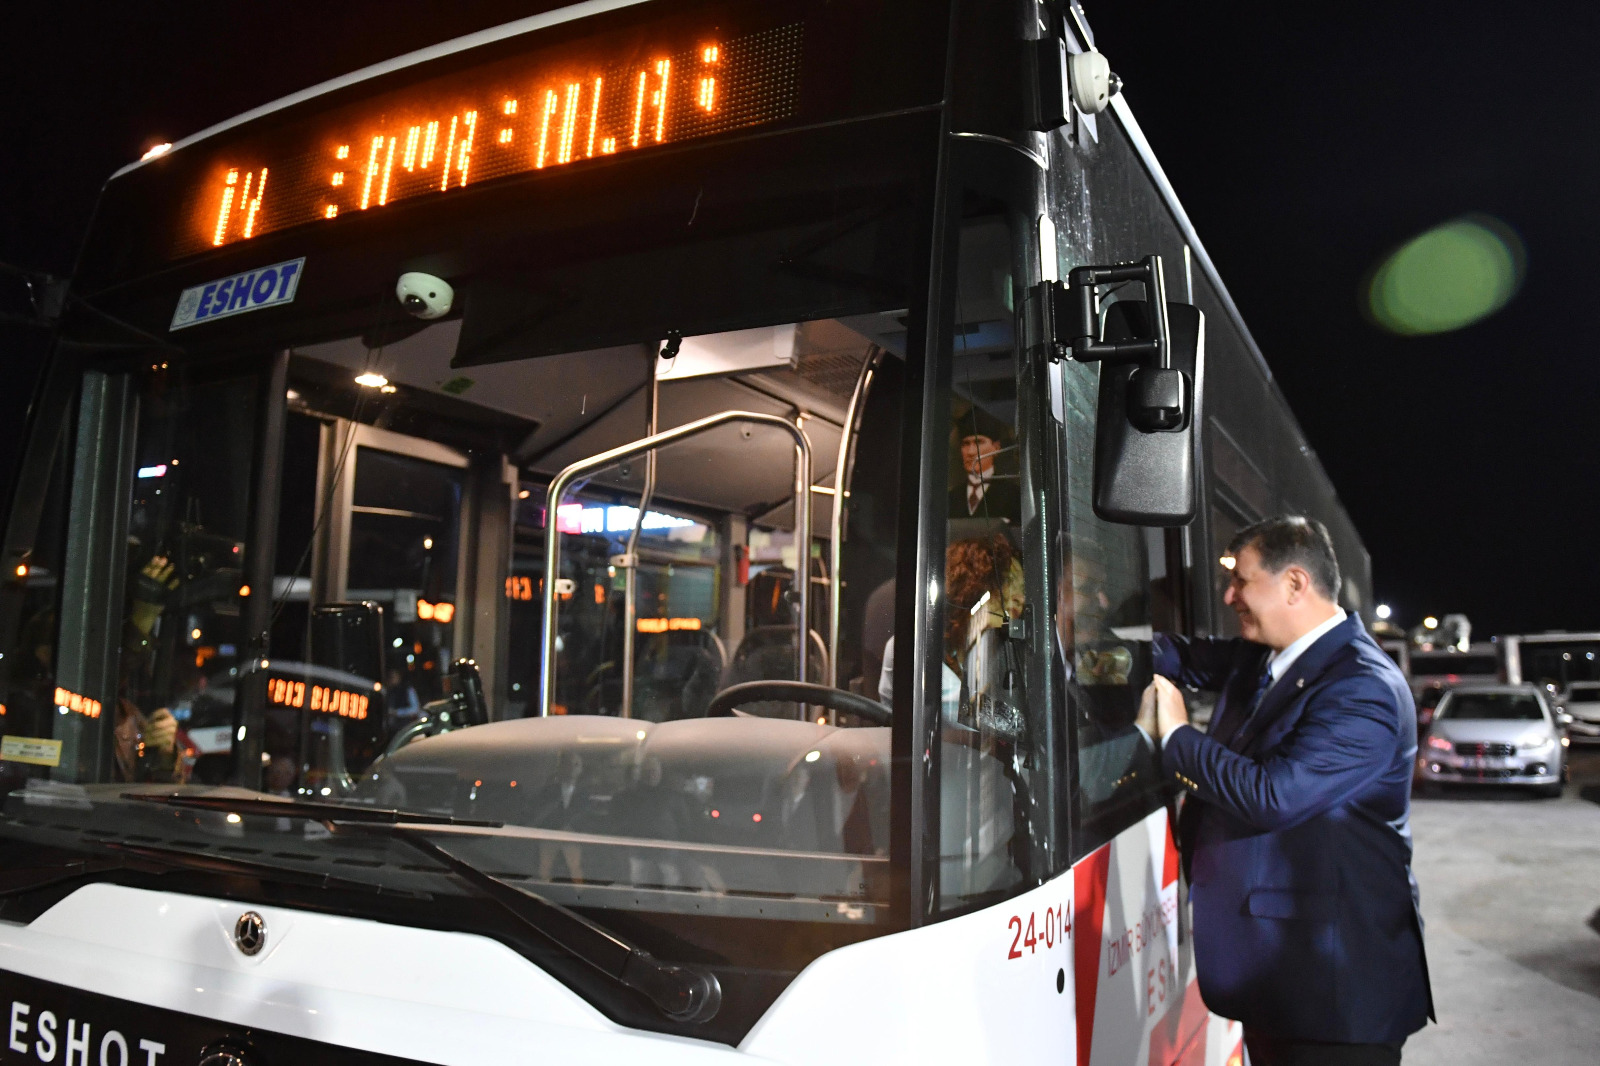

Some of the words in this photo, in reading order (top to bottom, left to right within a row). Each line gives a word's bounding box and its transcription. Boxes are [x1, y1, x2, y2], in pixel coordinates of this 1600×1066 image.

[195, 263, 299, 319] ESHOT
[1007, 898, 1072, 960] 24-014
[9, 1001, 166, 1066] ESHOT
